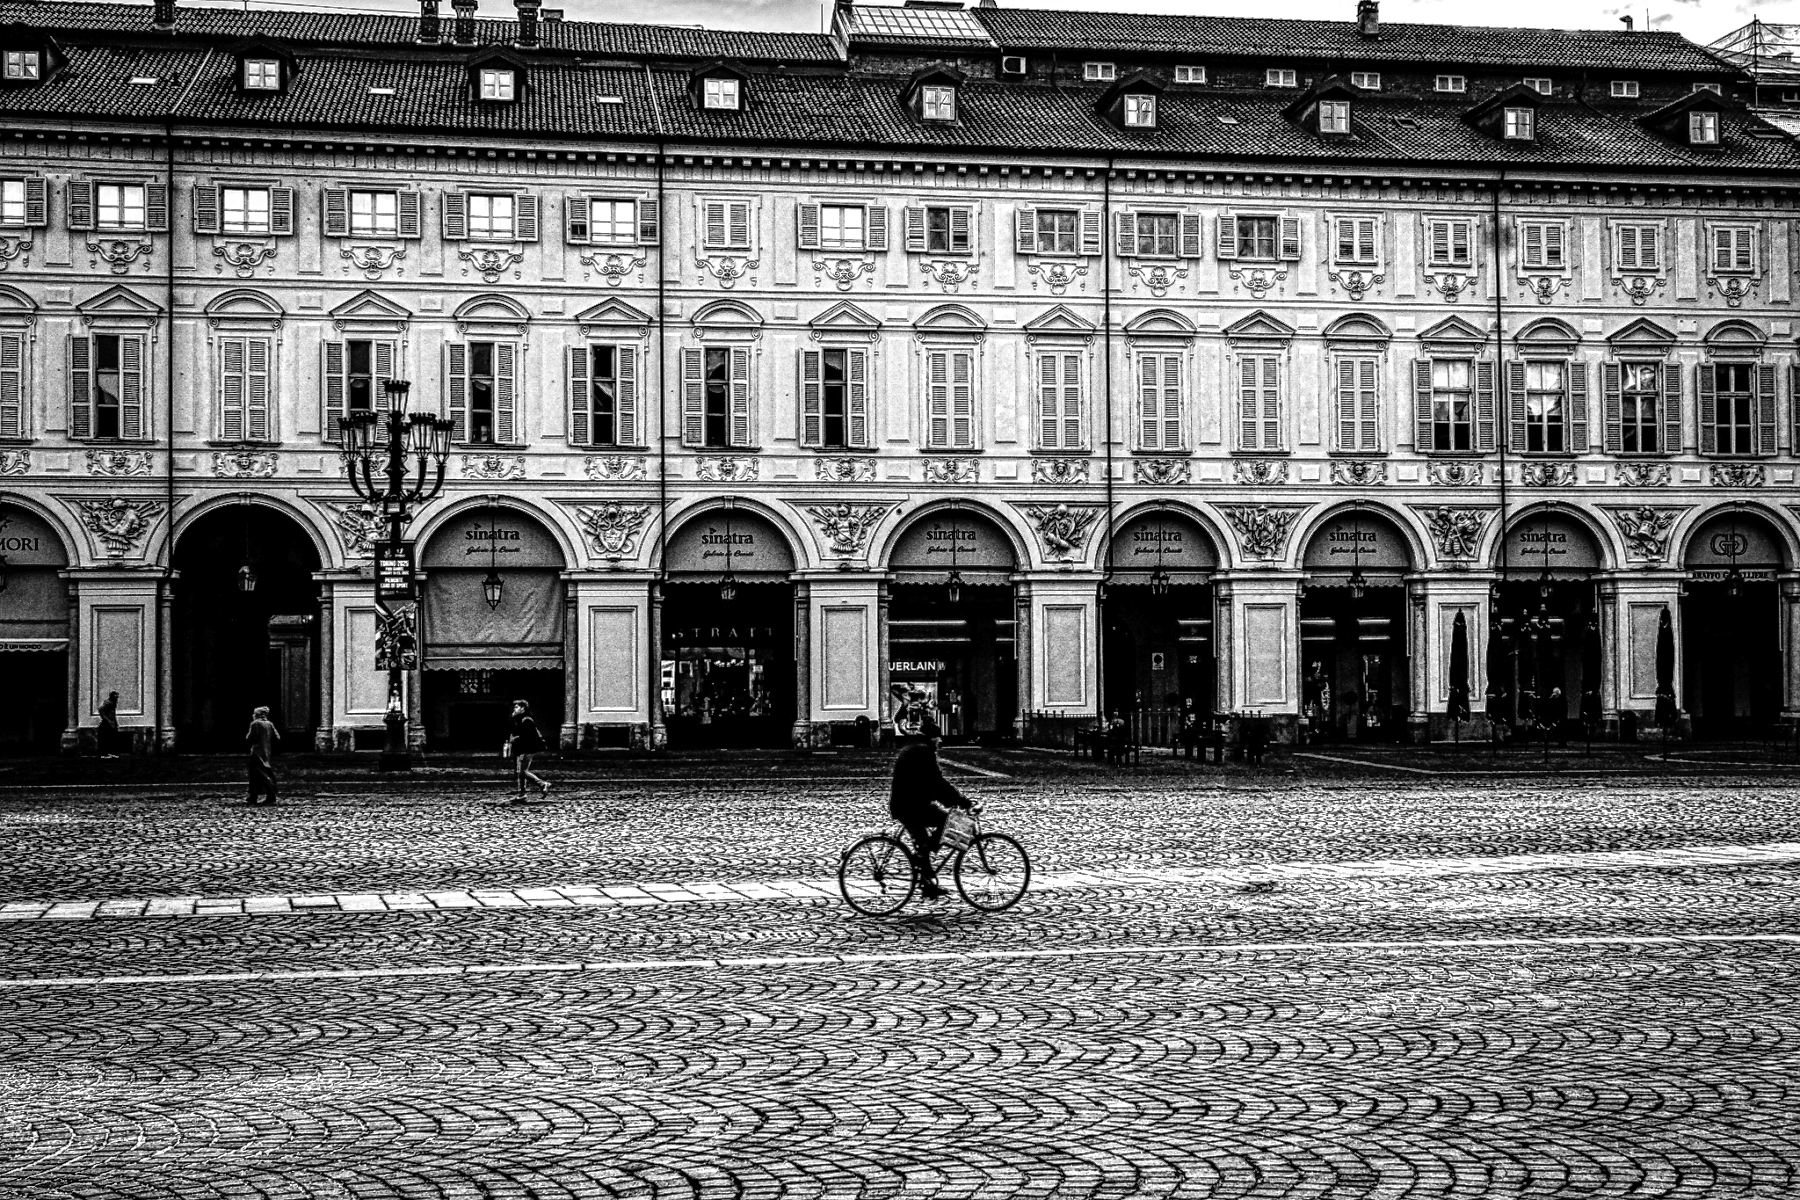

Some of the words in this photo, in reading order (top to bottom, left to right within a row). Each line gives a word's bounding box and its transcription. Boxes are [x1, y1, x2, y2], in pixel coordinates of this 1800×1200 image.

[465, 524, 521, 540] sinatra
[701, 529, 754, 544] sinatra
[926, 525, 976, 540] sinatra
[1134, 527, 1182, 541] sinatra
[1329, 527, 1376, 541] sinatra
[1520, 528, 1567, 542] sinatra
